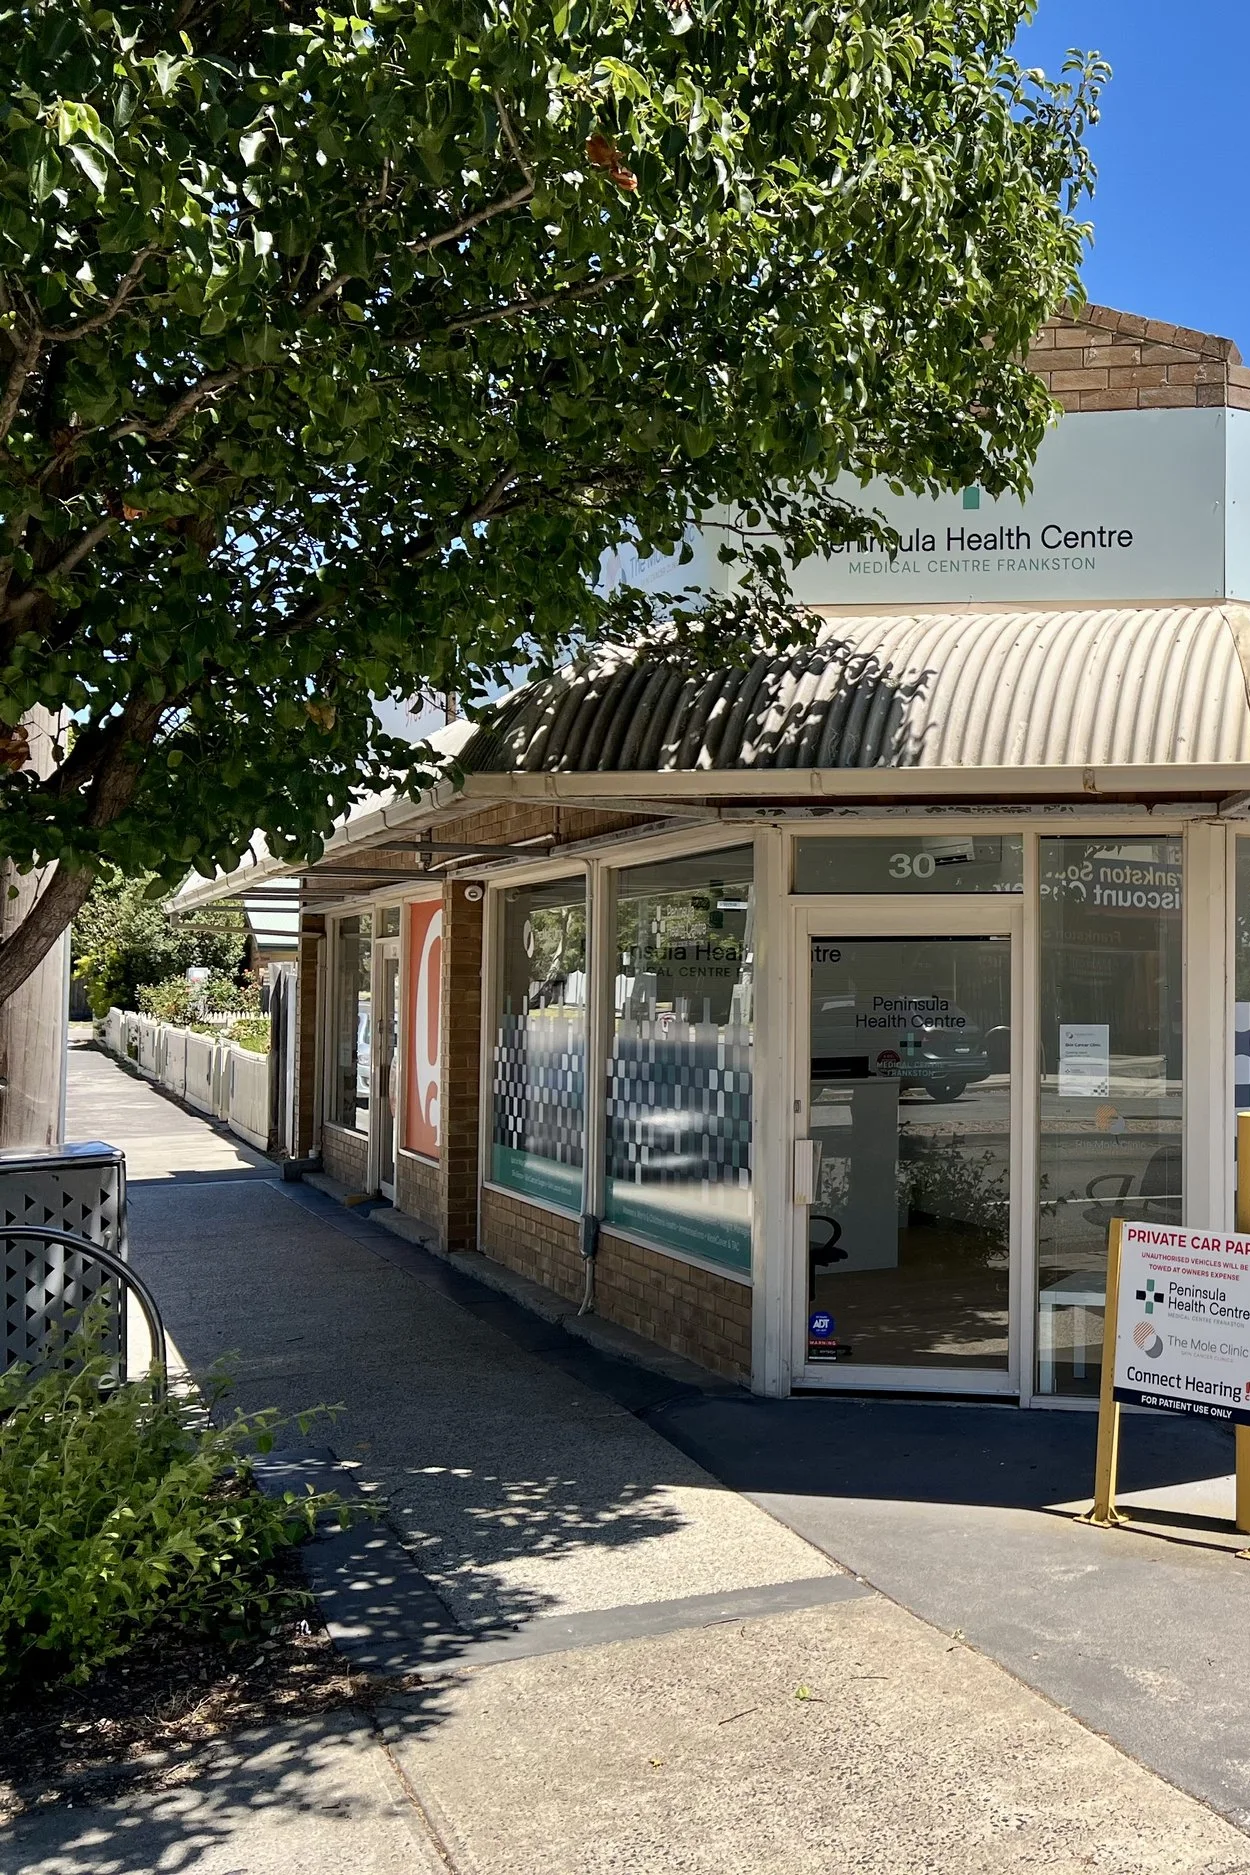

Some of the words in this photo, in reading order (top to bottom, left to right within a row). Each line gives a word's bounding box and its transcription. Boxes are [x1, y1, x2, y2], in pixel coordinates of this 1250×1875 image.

[946, 525, 1031, 551] Health
[1040, 524, 1134, 549] Centre
[849, 560, 921, 575] MEDICAL
[927, 558, 991, 573] CENTRE
[997, 556, 1096, 572] FRANKSTON
[889, 852, 936, 879] 30
[873, 995, 949, 1011] Peninsula
[856, 1014, 907, 1029] Health
[911, 1014, 966, 1029] Centre
[1127, 1228, 1187, 1248] PRIVATE
[1191, 1236, 1221, 1252] CAR
[1141, 1251, 1190, 1264] UNAUTHORISED
[1190, 1258, 1222, 1268] VEHICLES
[1222, 1261, 1239, 1270] WILL
[1149, 1263, 1172, 1273] TOWED
[1181, 1268, 1209, 1278] OWNERS
[1210, 1271, 1240, 1281] EXPENSE
[1168, 1281, 1226, 1302] Peninsula
[1167, 1312, 1190, 1321] MEDICAL
[1191, 1315, 1212, 1324] CENTRE
[1168, 1296, 1206, 1314] Health
[1209, 1302, 1250, 1320] Centre
[813, 1318, 830, 1329] ADT
[1167, 1334, 1188, 1349] The
[1190, 1338, 1217, 1353] Mole
[1219, 1342, 1249, 1359] Clinic
[1127, 1366, 1182, 1390] Connect
[1185, 1376, 1242, 1403] Hearing
[1141, 1394, 1158, 1406] FOR
[1158, 1396, 1191, 1412] PATIENT
[1192, 1405, 1210, 1416] USE
[1210, 1407, 1232, 1420] ONLY
